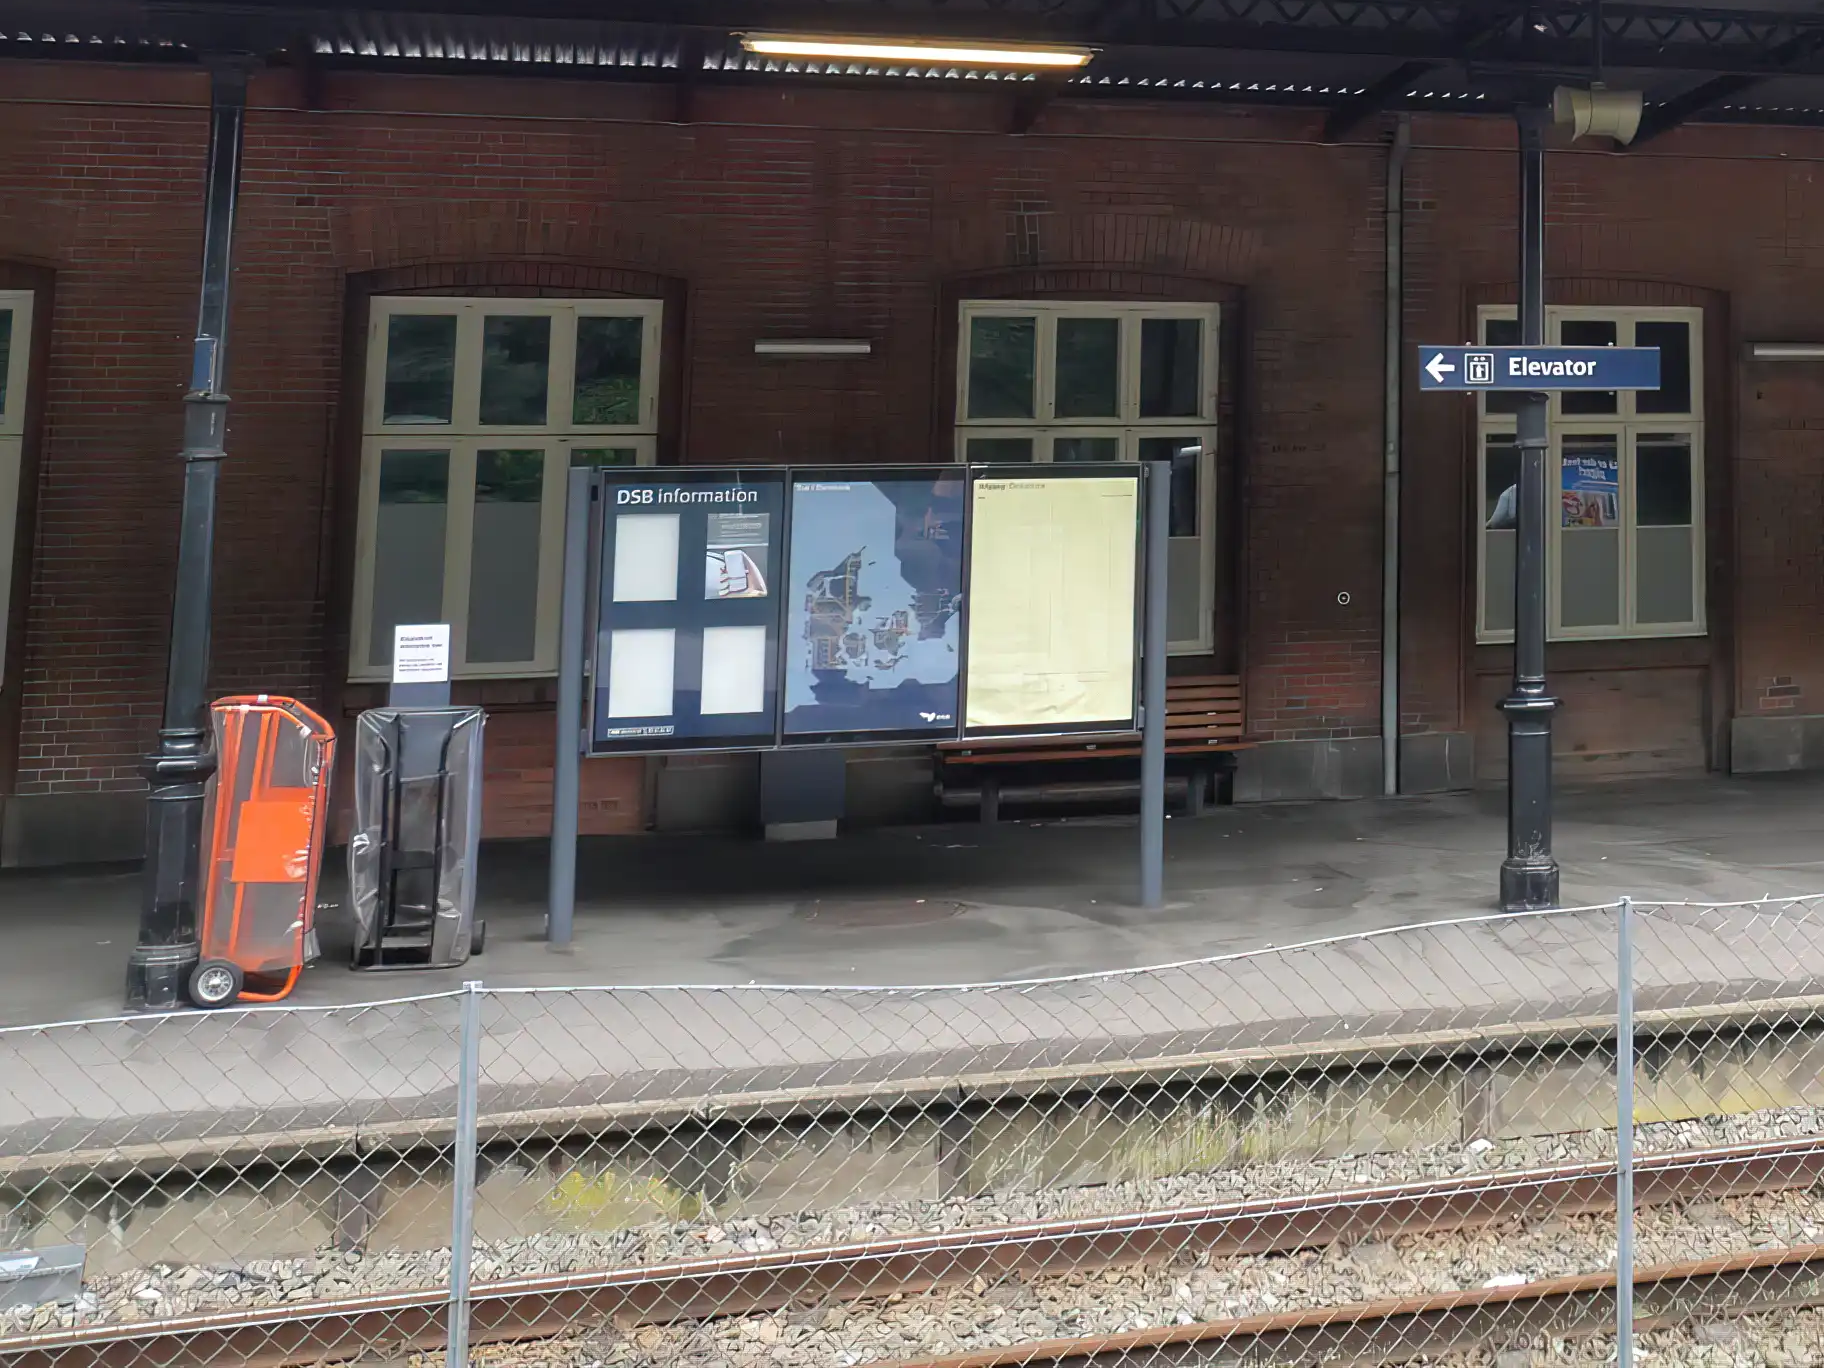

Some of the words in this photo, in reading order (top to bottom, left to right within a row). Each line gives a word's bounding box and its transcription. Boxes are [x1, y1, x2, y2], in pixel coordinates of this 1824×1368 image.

[1508, 356, 1597, 376] Elevator
[617, 489, 654, 505] DSB
[658, 488, 758, 504] information
